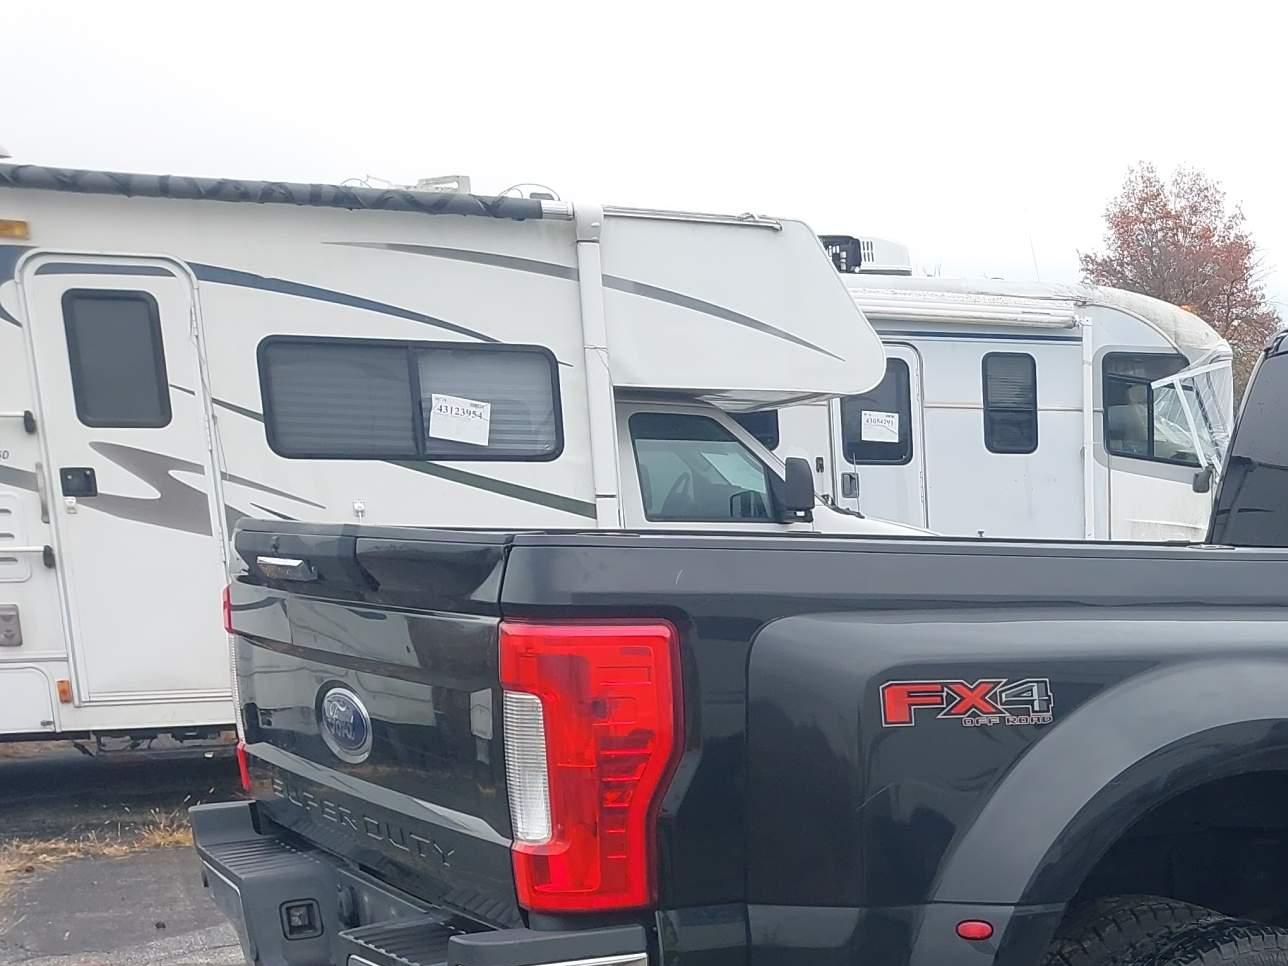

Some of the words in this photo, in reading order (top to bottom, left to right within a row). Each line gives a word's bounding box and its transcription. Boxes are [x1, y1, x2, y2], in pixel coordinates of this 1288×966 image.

[880, 678, 1054, 728] FX4
[962, 717, 1001, 728] OFF
[1005, 714, 1053, 726] ROAD
[273, 779, 358, 831] SUPER
[363, 815, 456, 868] DUTY
